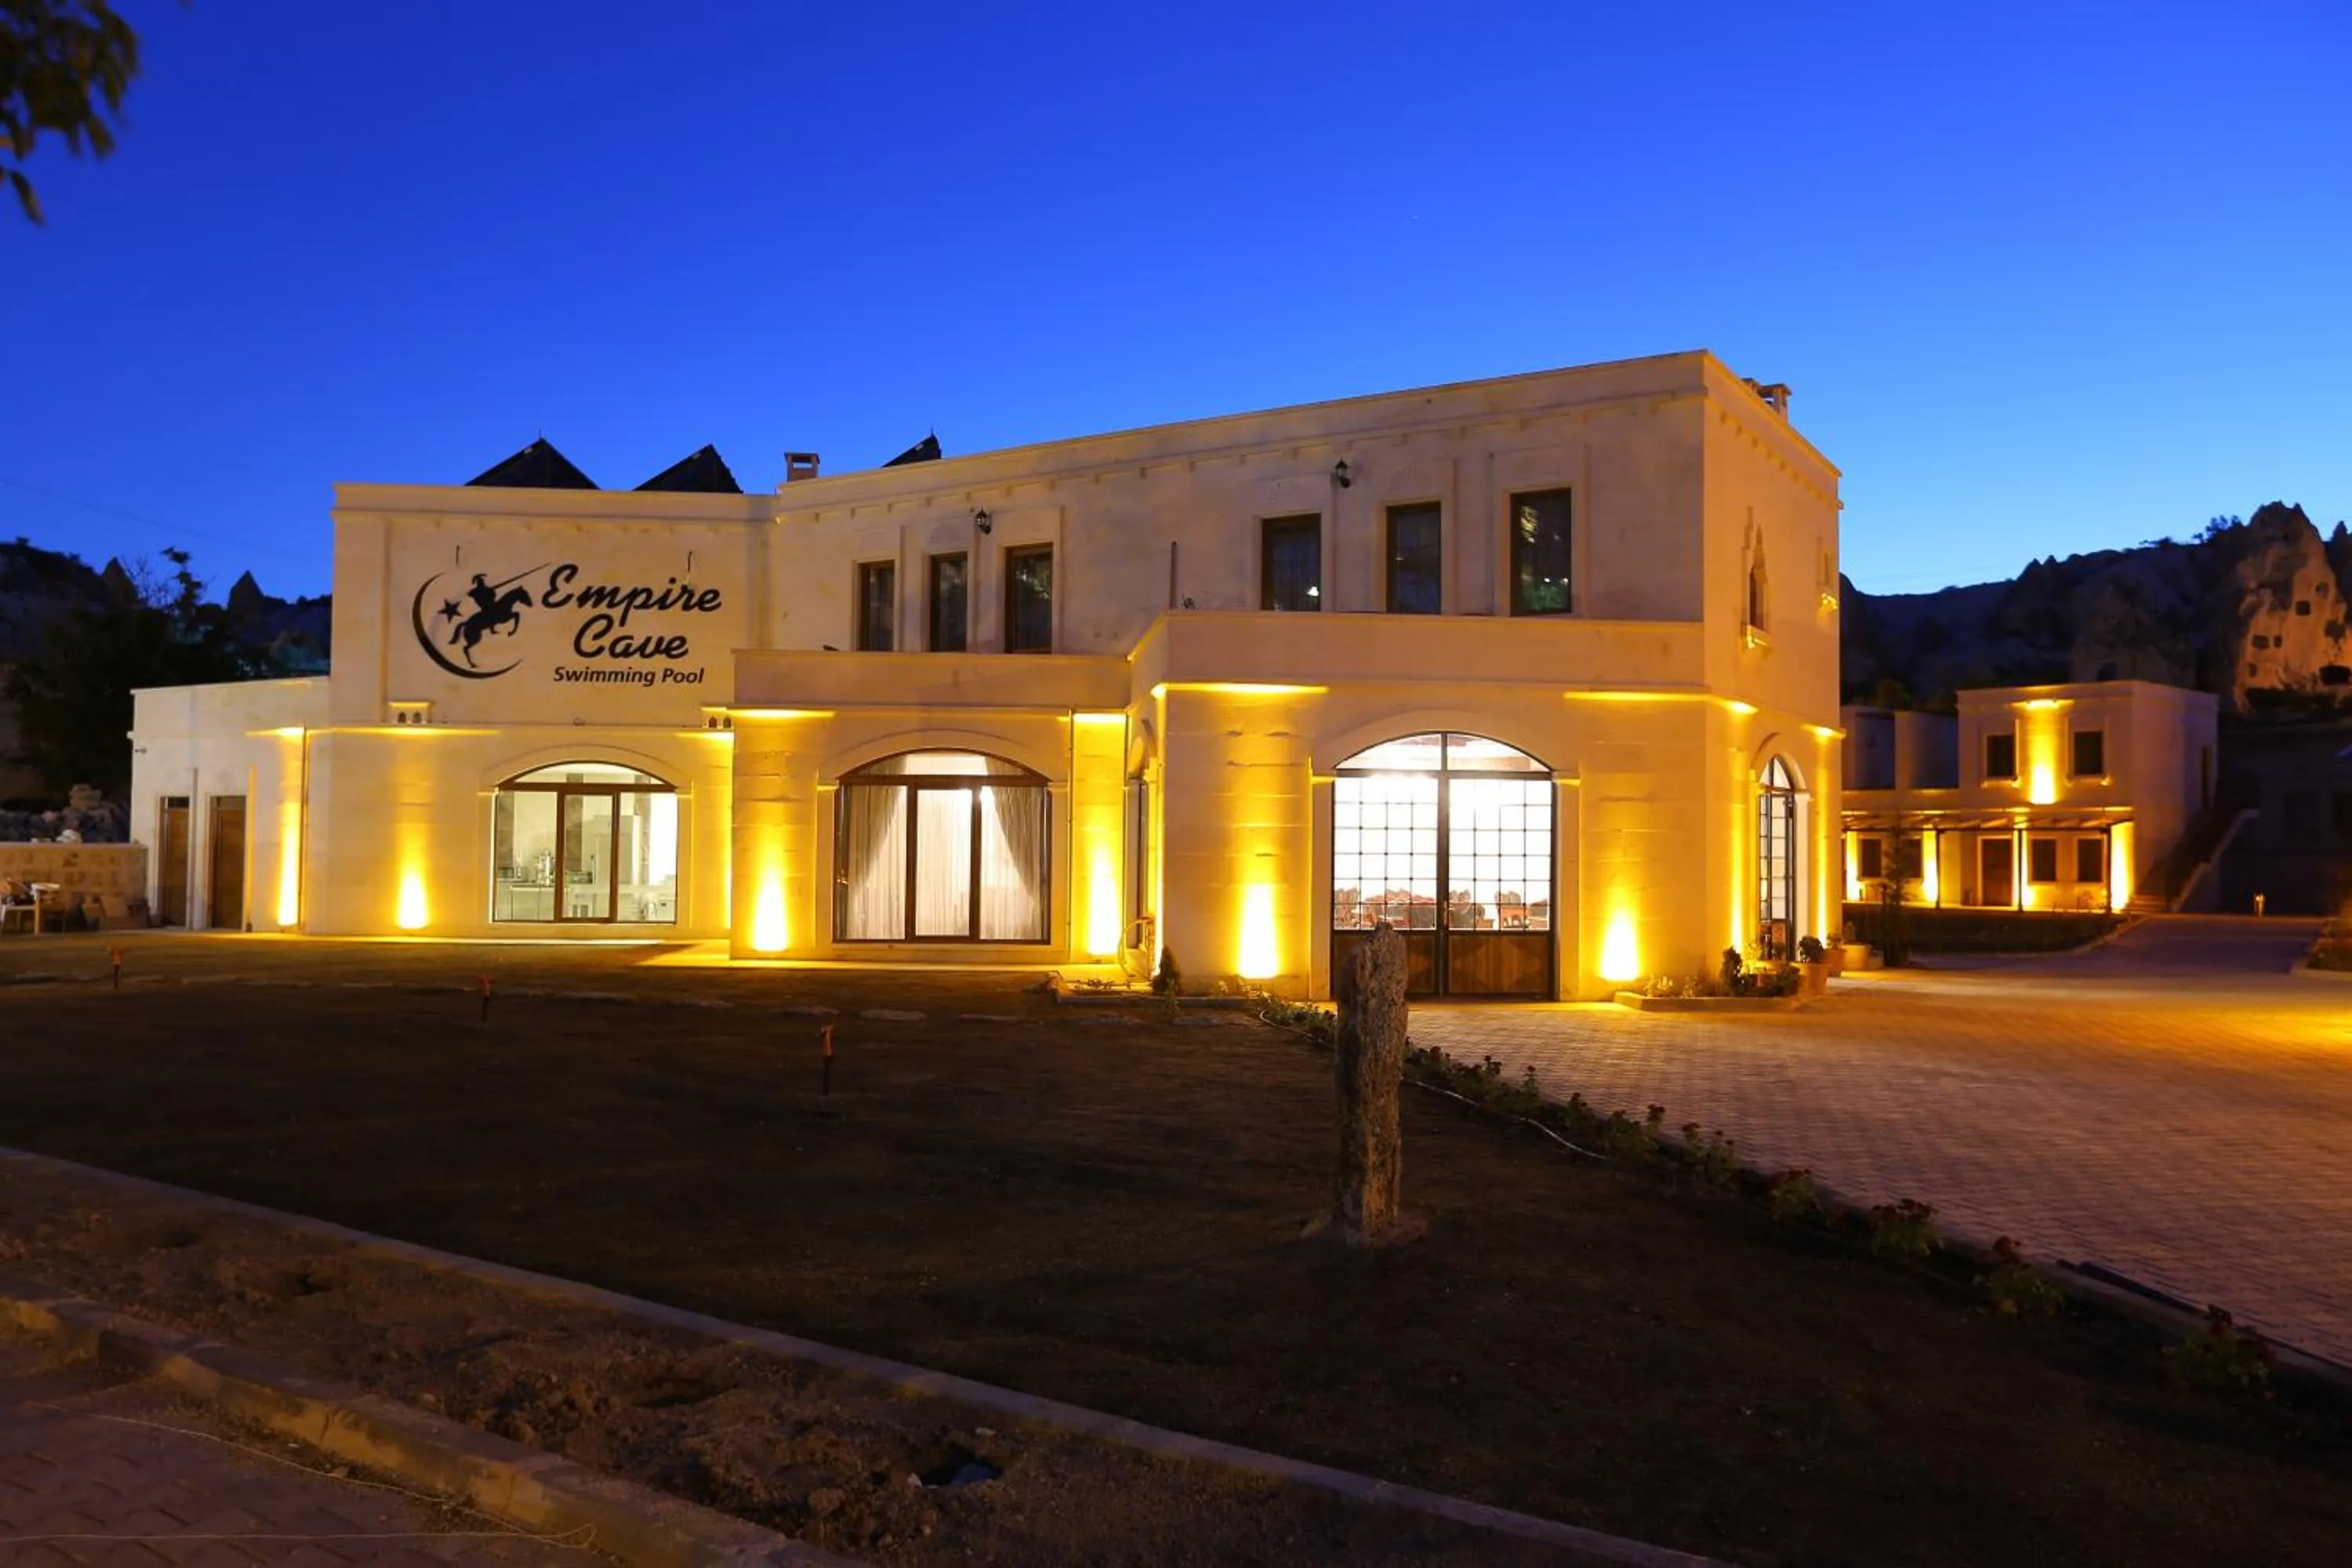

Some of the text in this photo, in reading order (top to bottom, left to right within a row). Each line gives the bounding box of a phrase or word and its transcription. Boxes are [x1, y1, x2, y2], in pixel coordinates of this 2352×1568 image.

[541, 564, 722, 627] Empire
[573, 614, 689, 659] Cave
[554, 666, 705, 687] Swimming Pool
